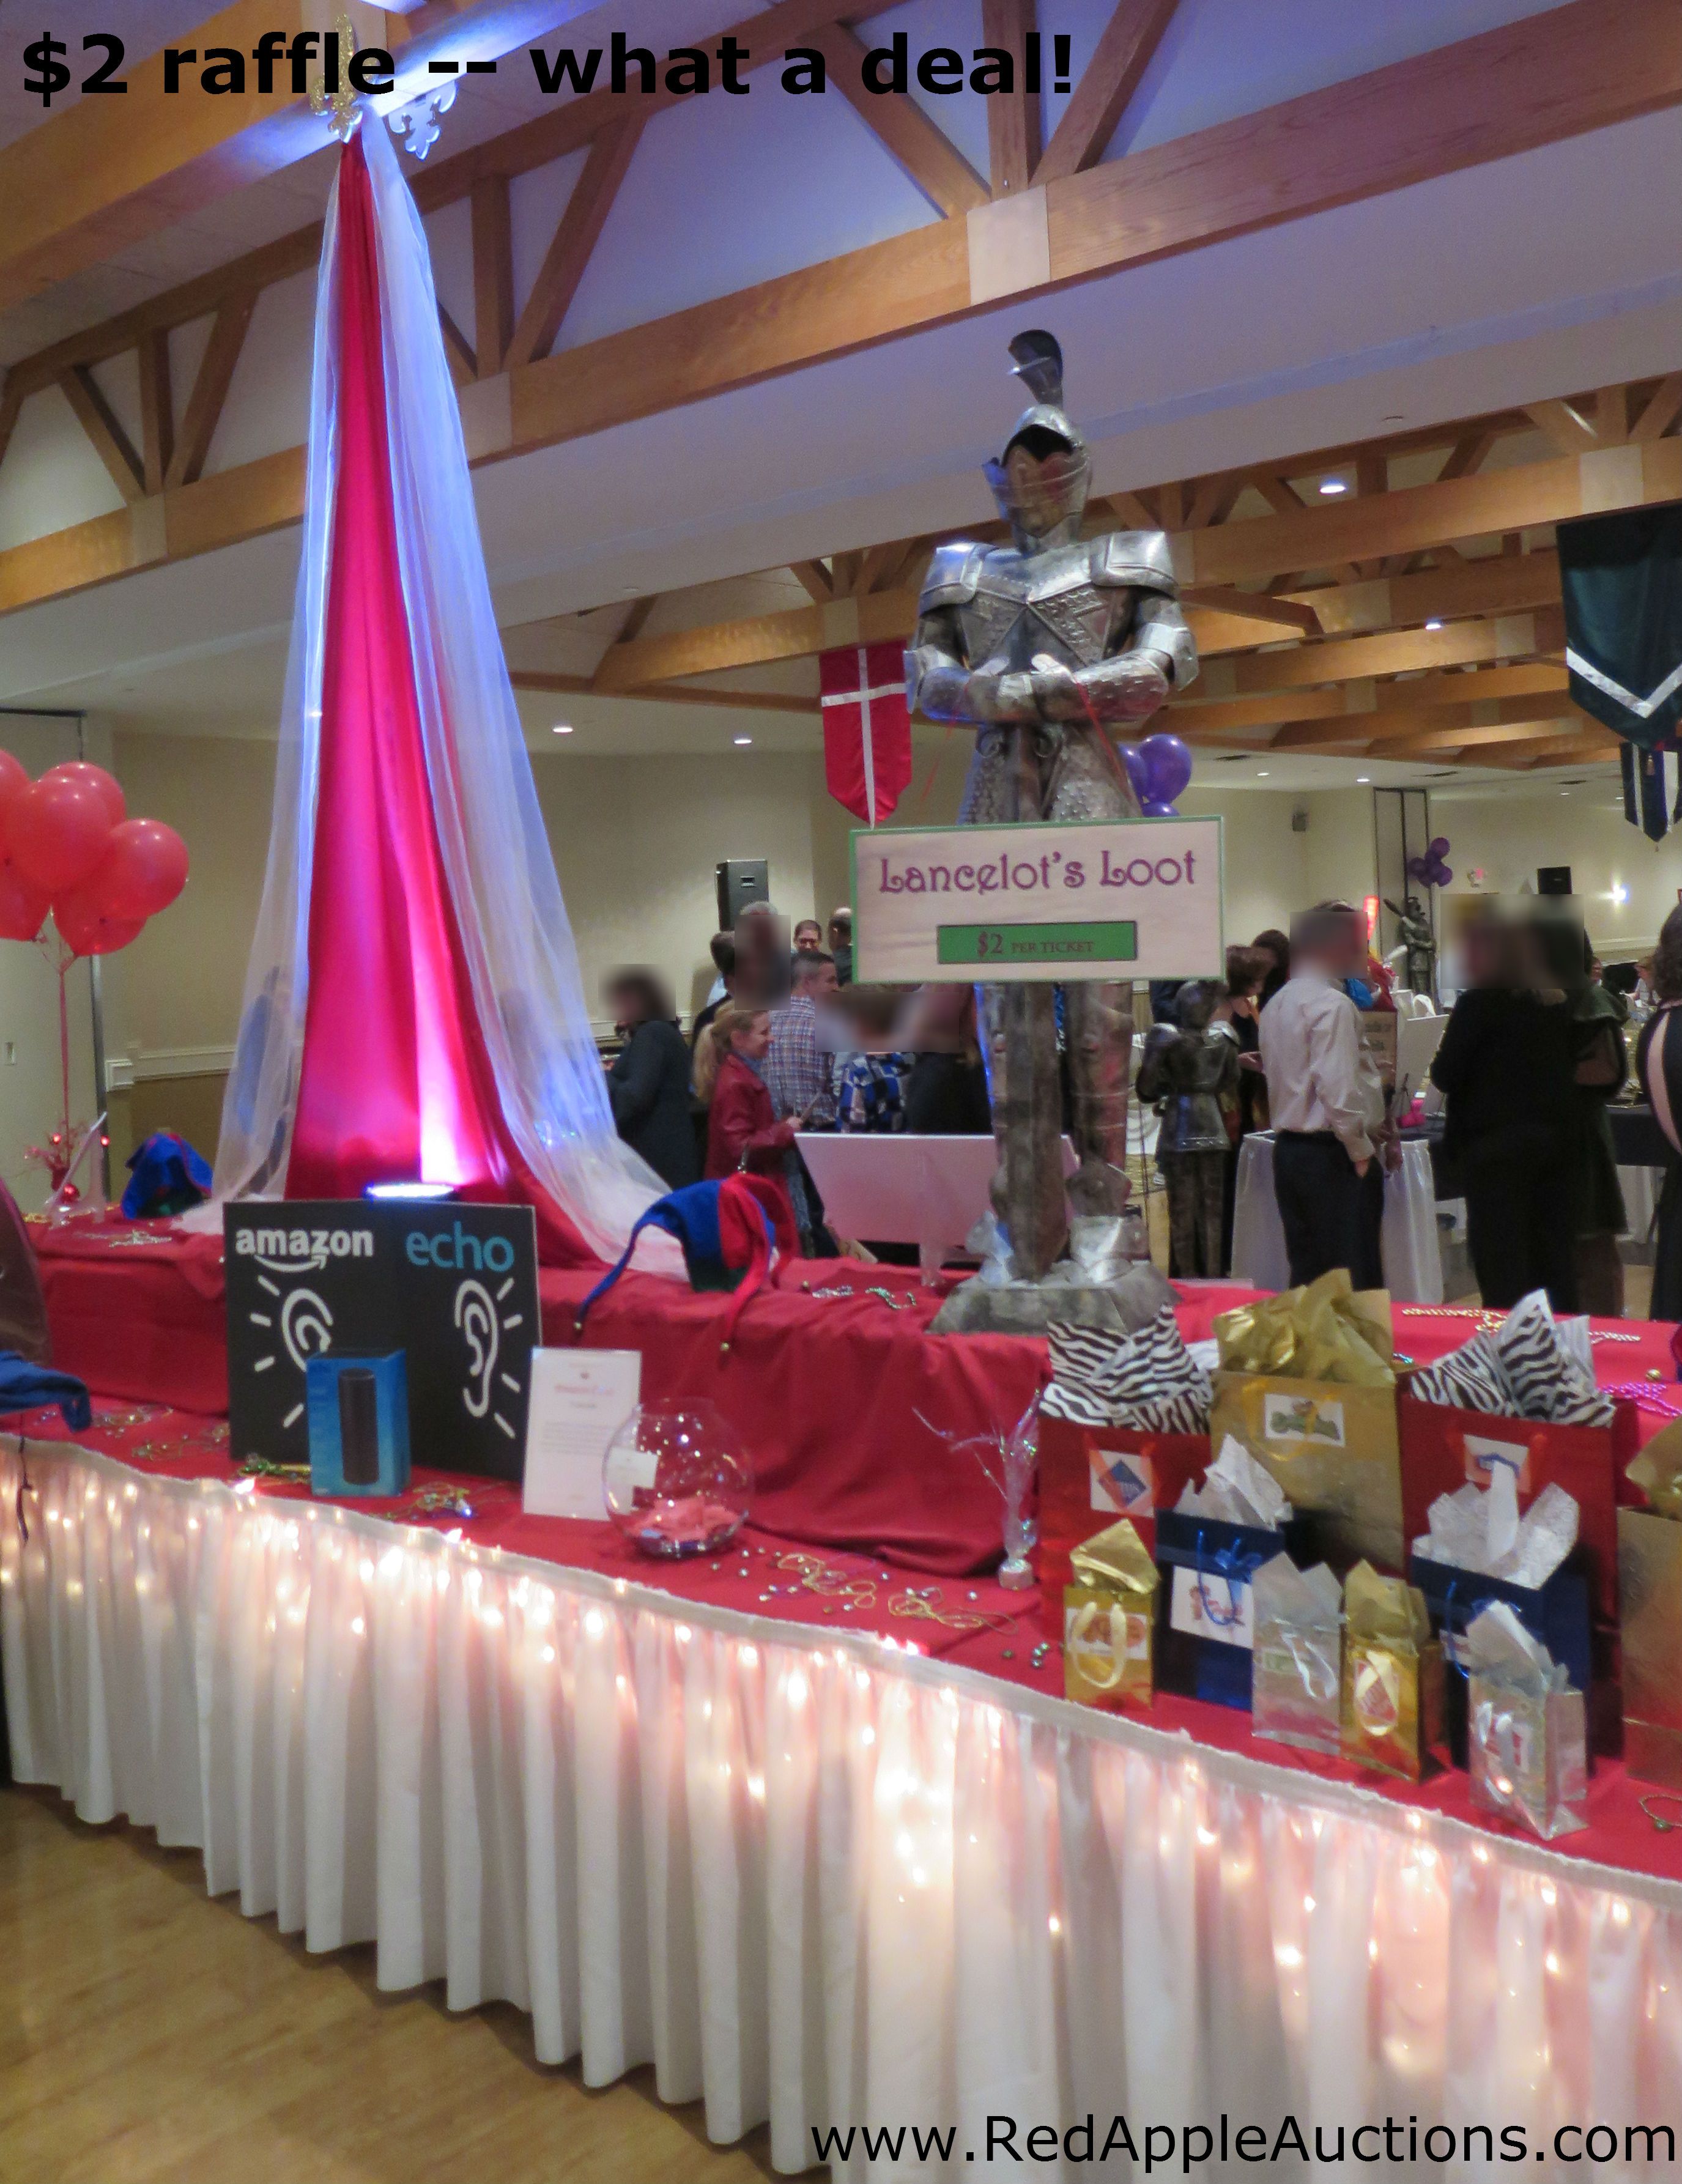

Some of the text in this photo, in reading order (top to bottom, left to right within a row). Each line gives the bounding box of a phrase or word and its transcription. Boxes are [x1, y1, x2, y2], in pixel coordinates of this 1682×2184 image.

[879, 849, 1196, 895] Lancelot's Loot
[977, 930, 1094, 957] $2 PER TICKET
[235, 1228, 374, 1257] amazon
[406, 1221, 515, 1273] echo
